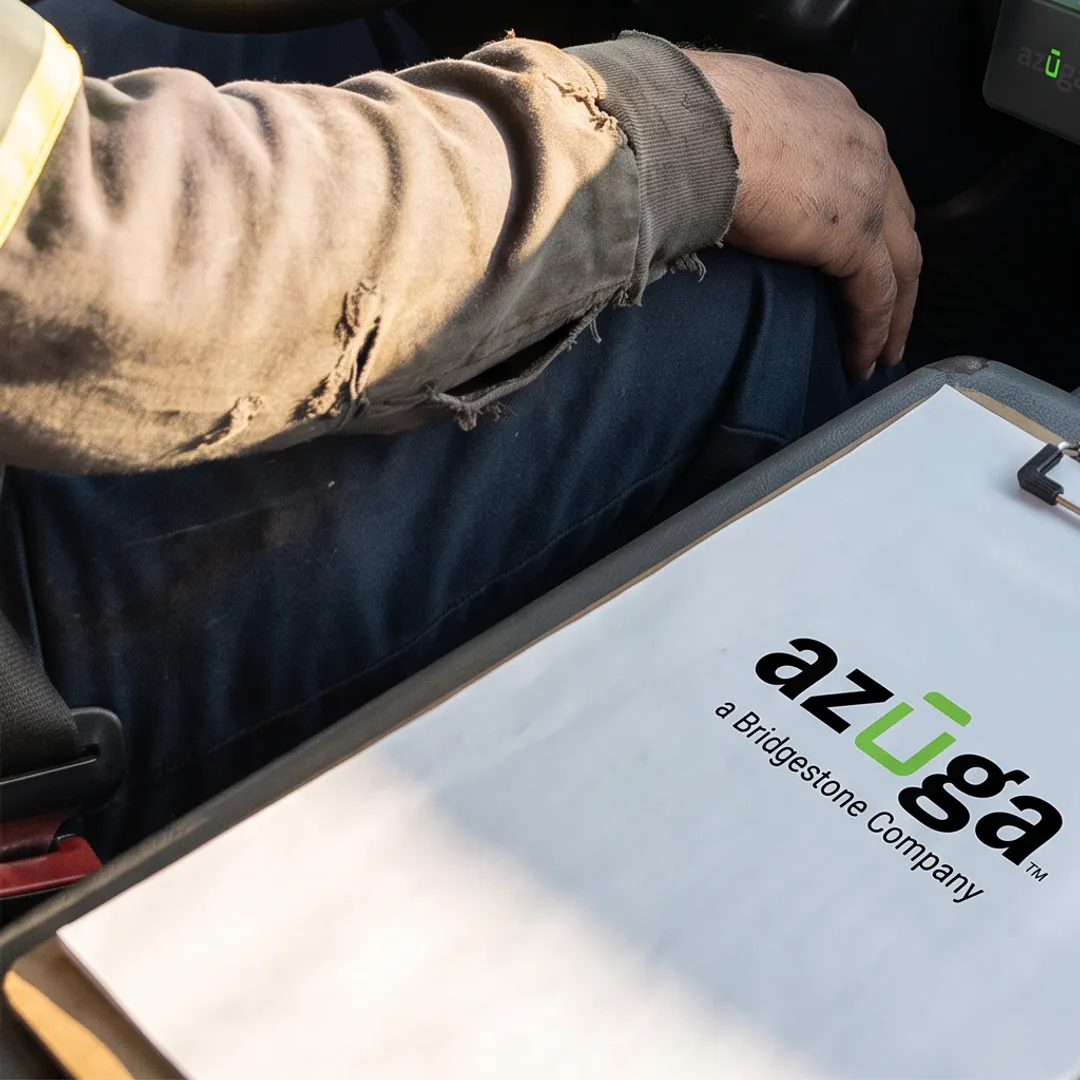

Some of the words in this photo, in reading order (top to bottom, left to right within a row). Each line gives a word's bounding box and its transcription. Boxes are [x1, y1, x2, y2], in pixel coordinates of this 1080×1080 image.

[715, 701, 736, 719] a
[732, 711, 868, 817] Bridgestone
[866, 811, 984, 903] Company
